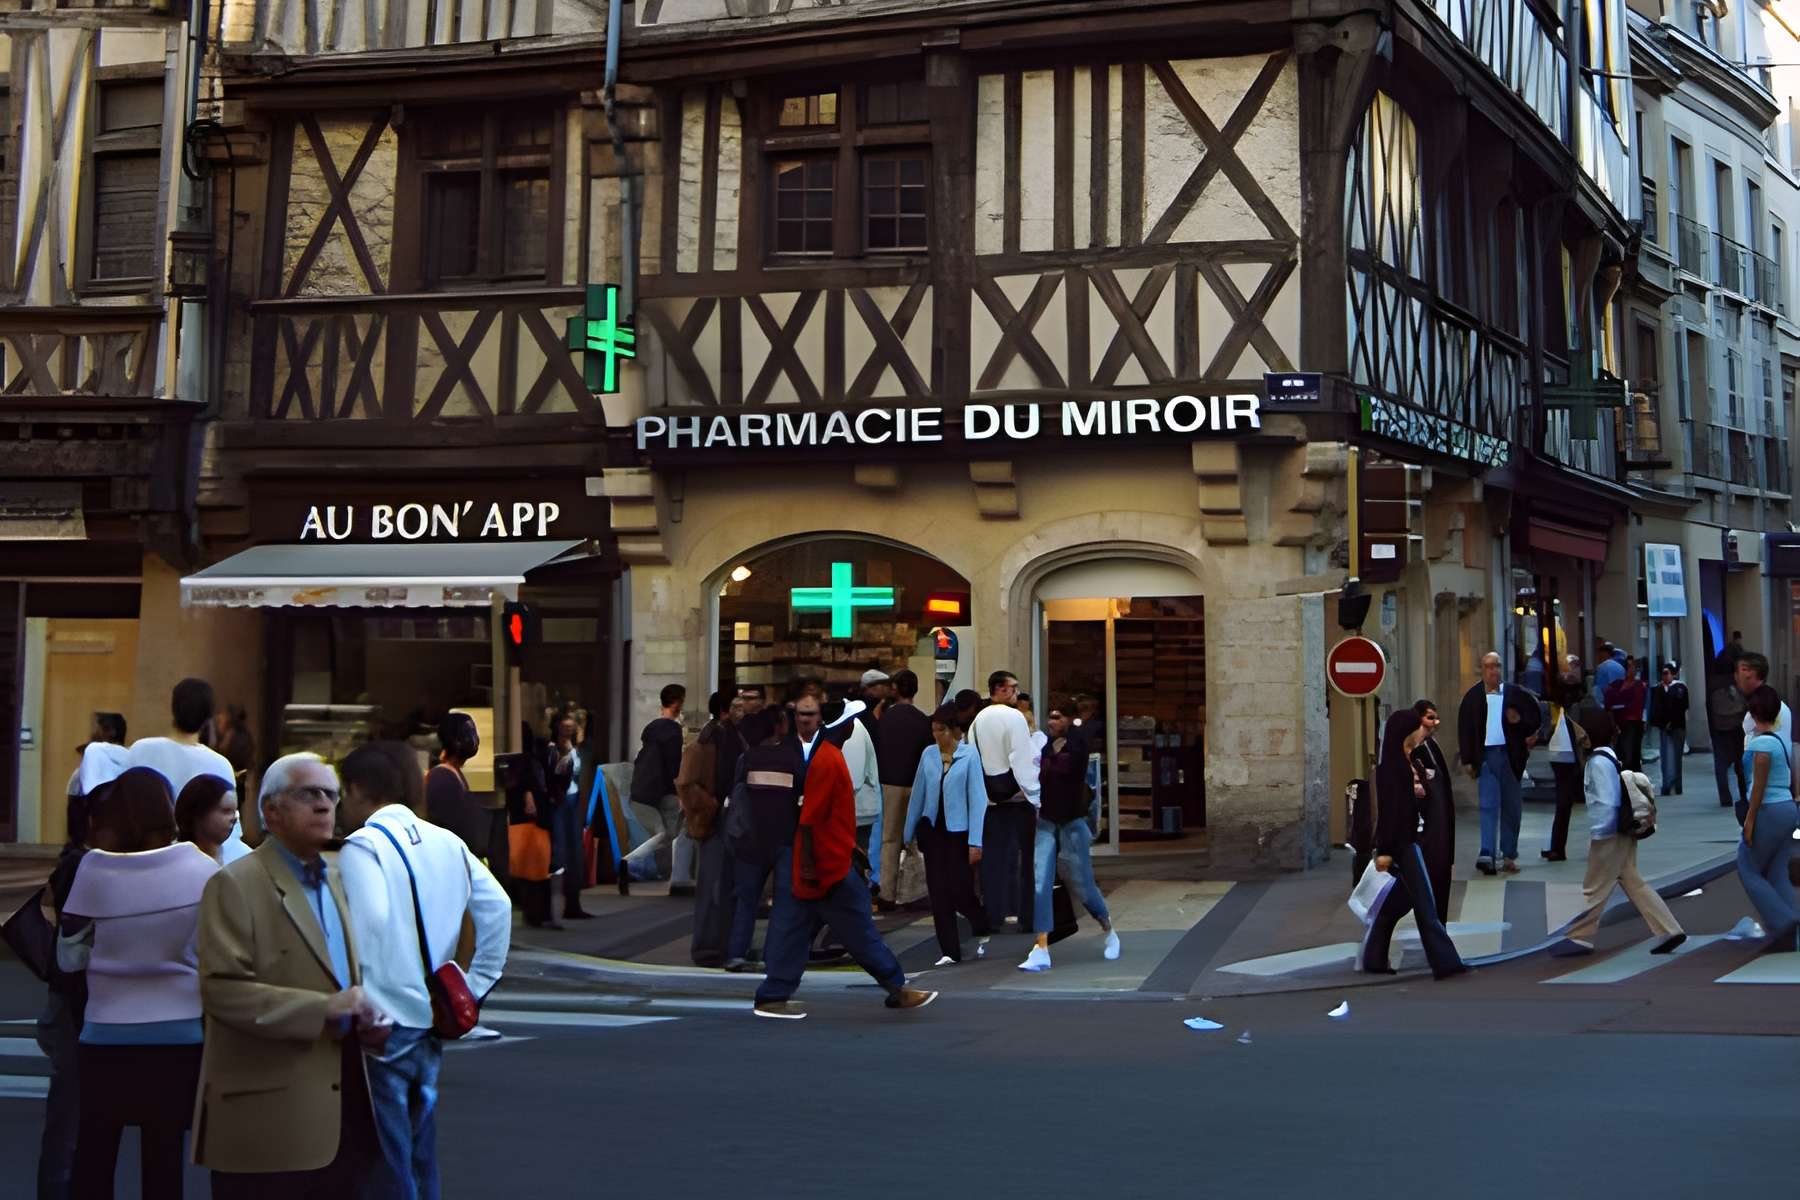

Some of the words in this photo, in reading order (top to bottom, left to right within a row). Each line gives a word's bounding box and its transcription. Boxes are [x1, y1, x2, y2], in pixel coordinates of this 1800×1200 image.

[636, 407, 943, 450] PHARMACIE
[964, 403, 1040, 440] DU
[1062, 394, 1261, 436] MIROIR
[300, 505, 354, 540] AU
[480, 502, 561, 537] APP
